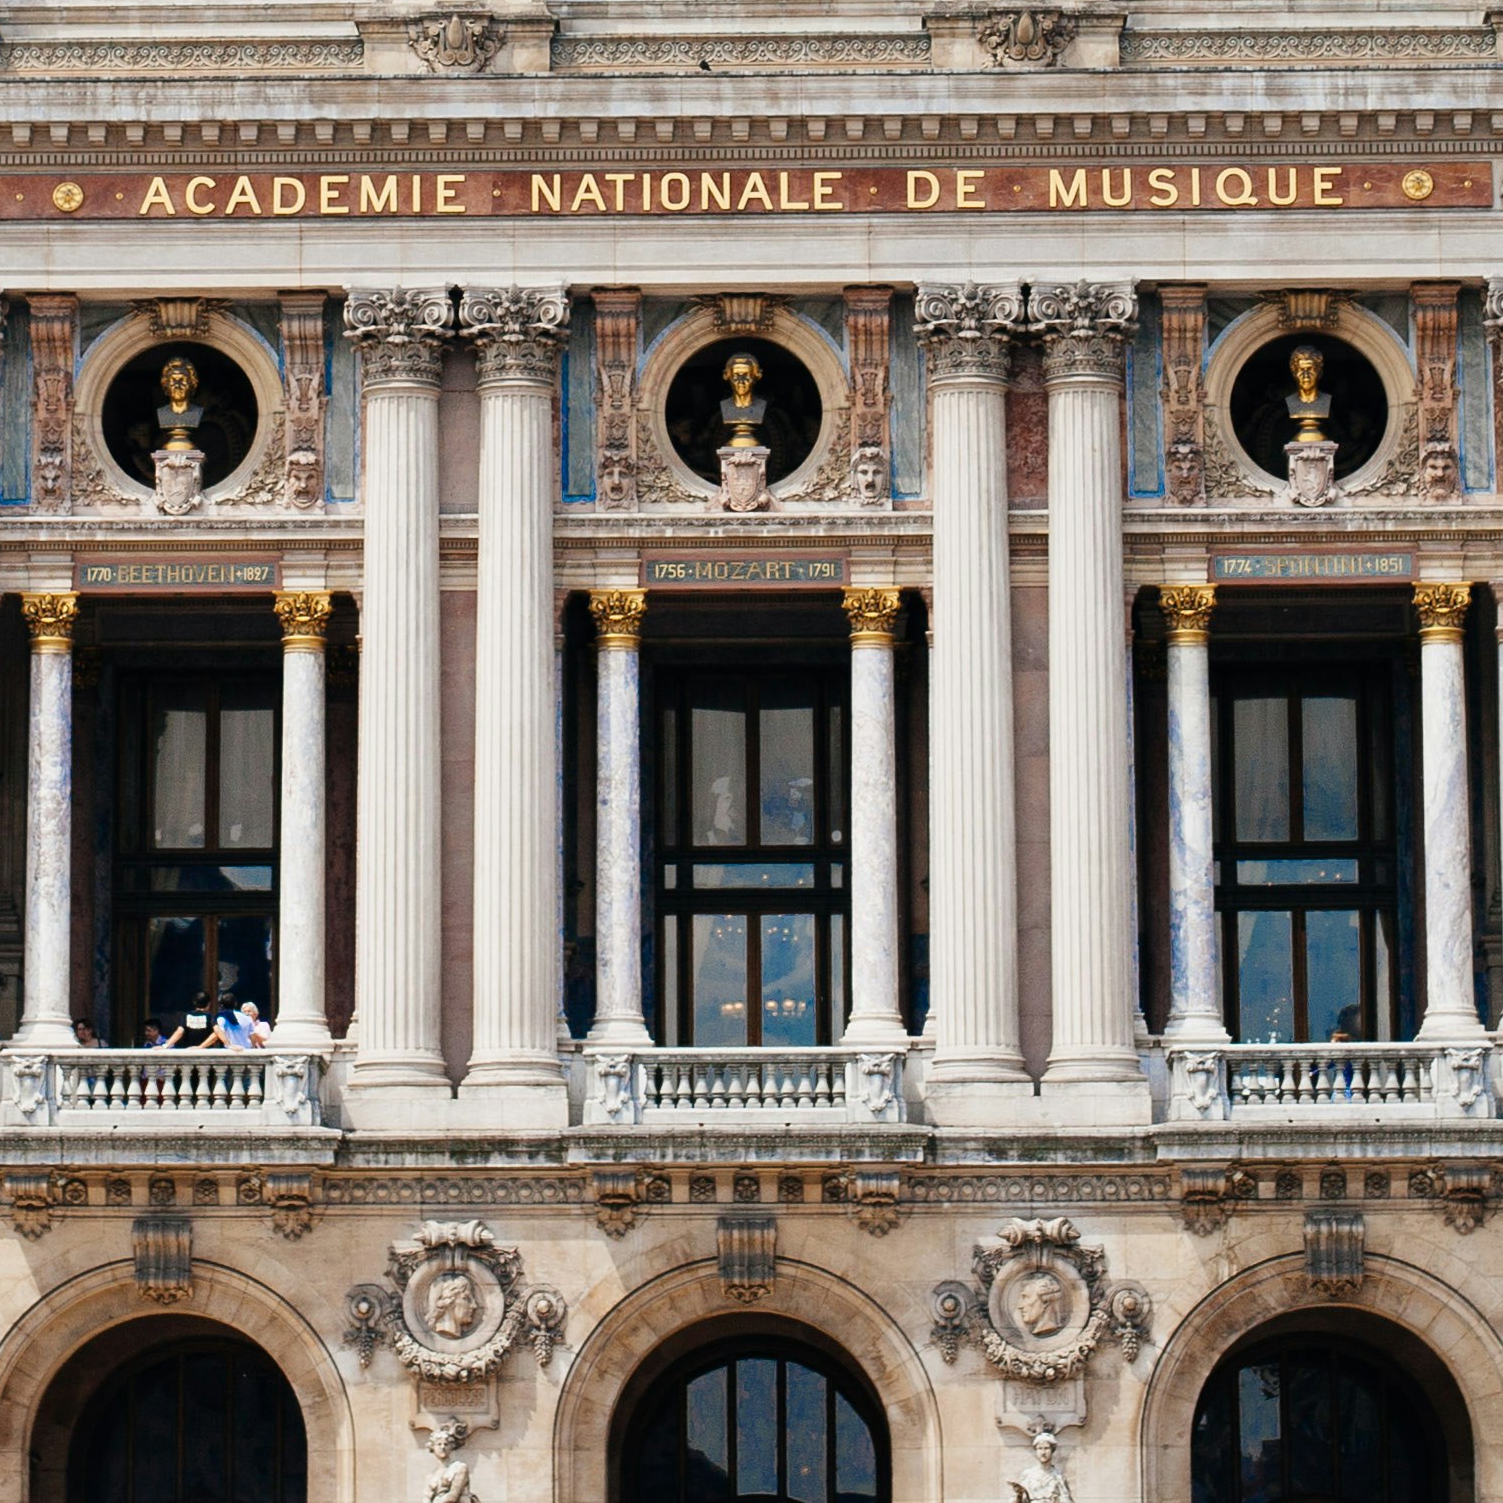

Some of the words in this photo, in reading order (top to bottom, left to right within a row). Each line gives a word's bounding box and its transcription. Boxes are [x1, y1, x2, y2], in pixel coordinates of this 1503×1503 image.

[139, 173, 468, 215] ACADEMIE
[531, 171, 844, 212] NATIONALE
[906, 169, 986, 210] DE
[1049, 166, 1344, 208] MUSIQUE
[87, 567, 112, 582] 1770
[117, 565, 235, 584] BEETHOVEN
[243, 566, 268, 581] 1827
[655, 563, 686, 579] 1756
[695, 561, 795, 580] MOZART
[808, 563, 835, 577] 1791
[1223, 559, 1252, 574] 1774
[1375, 557, 1403, 572] 1851
